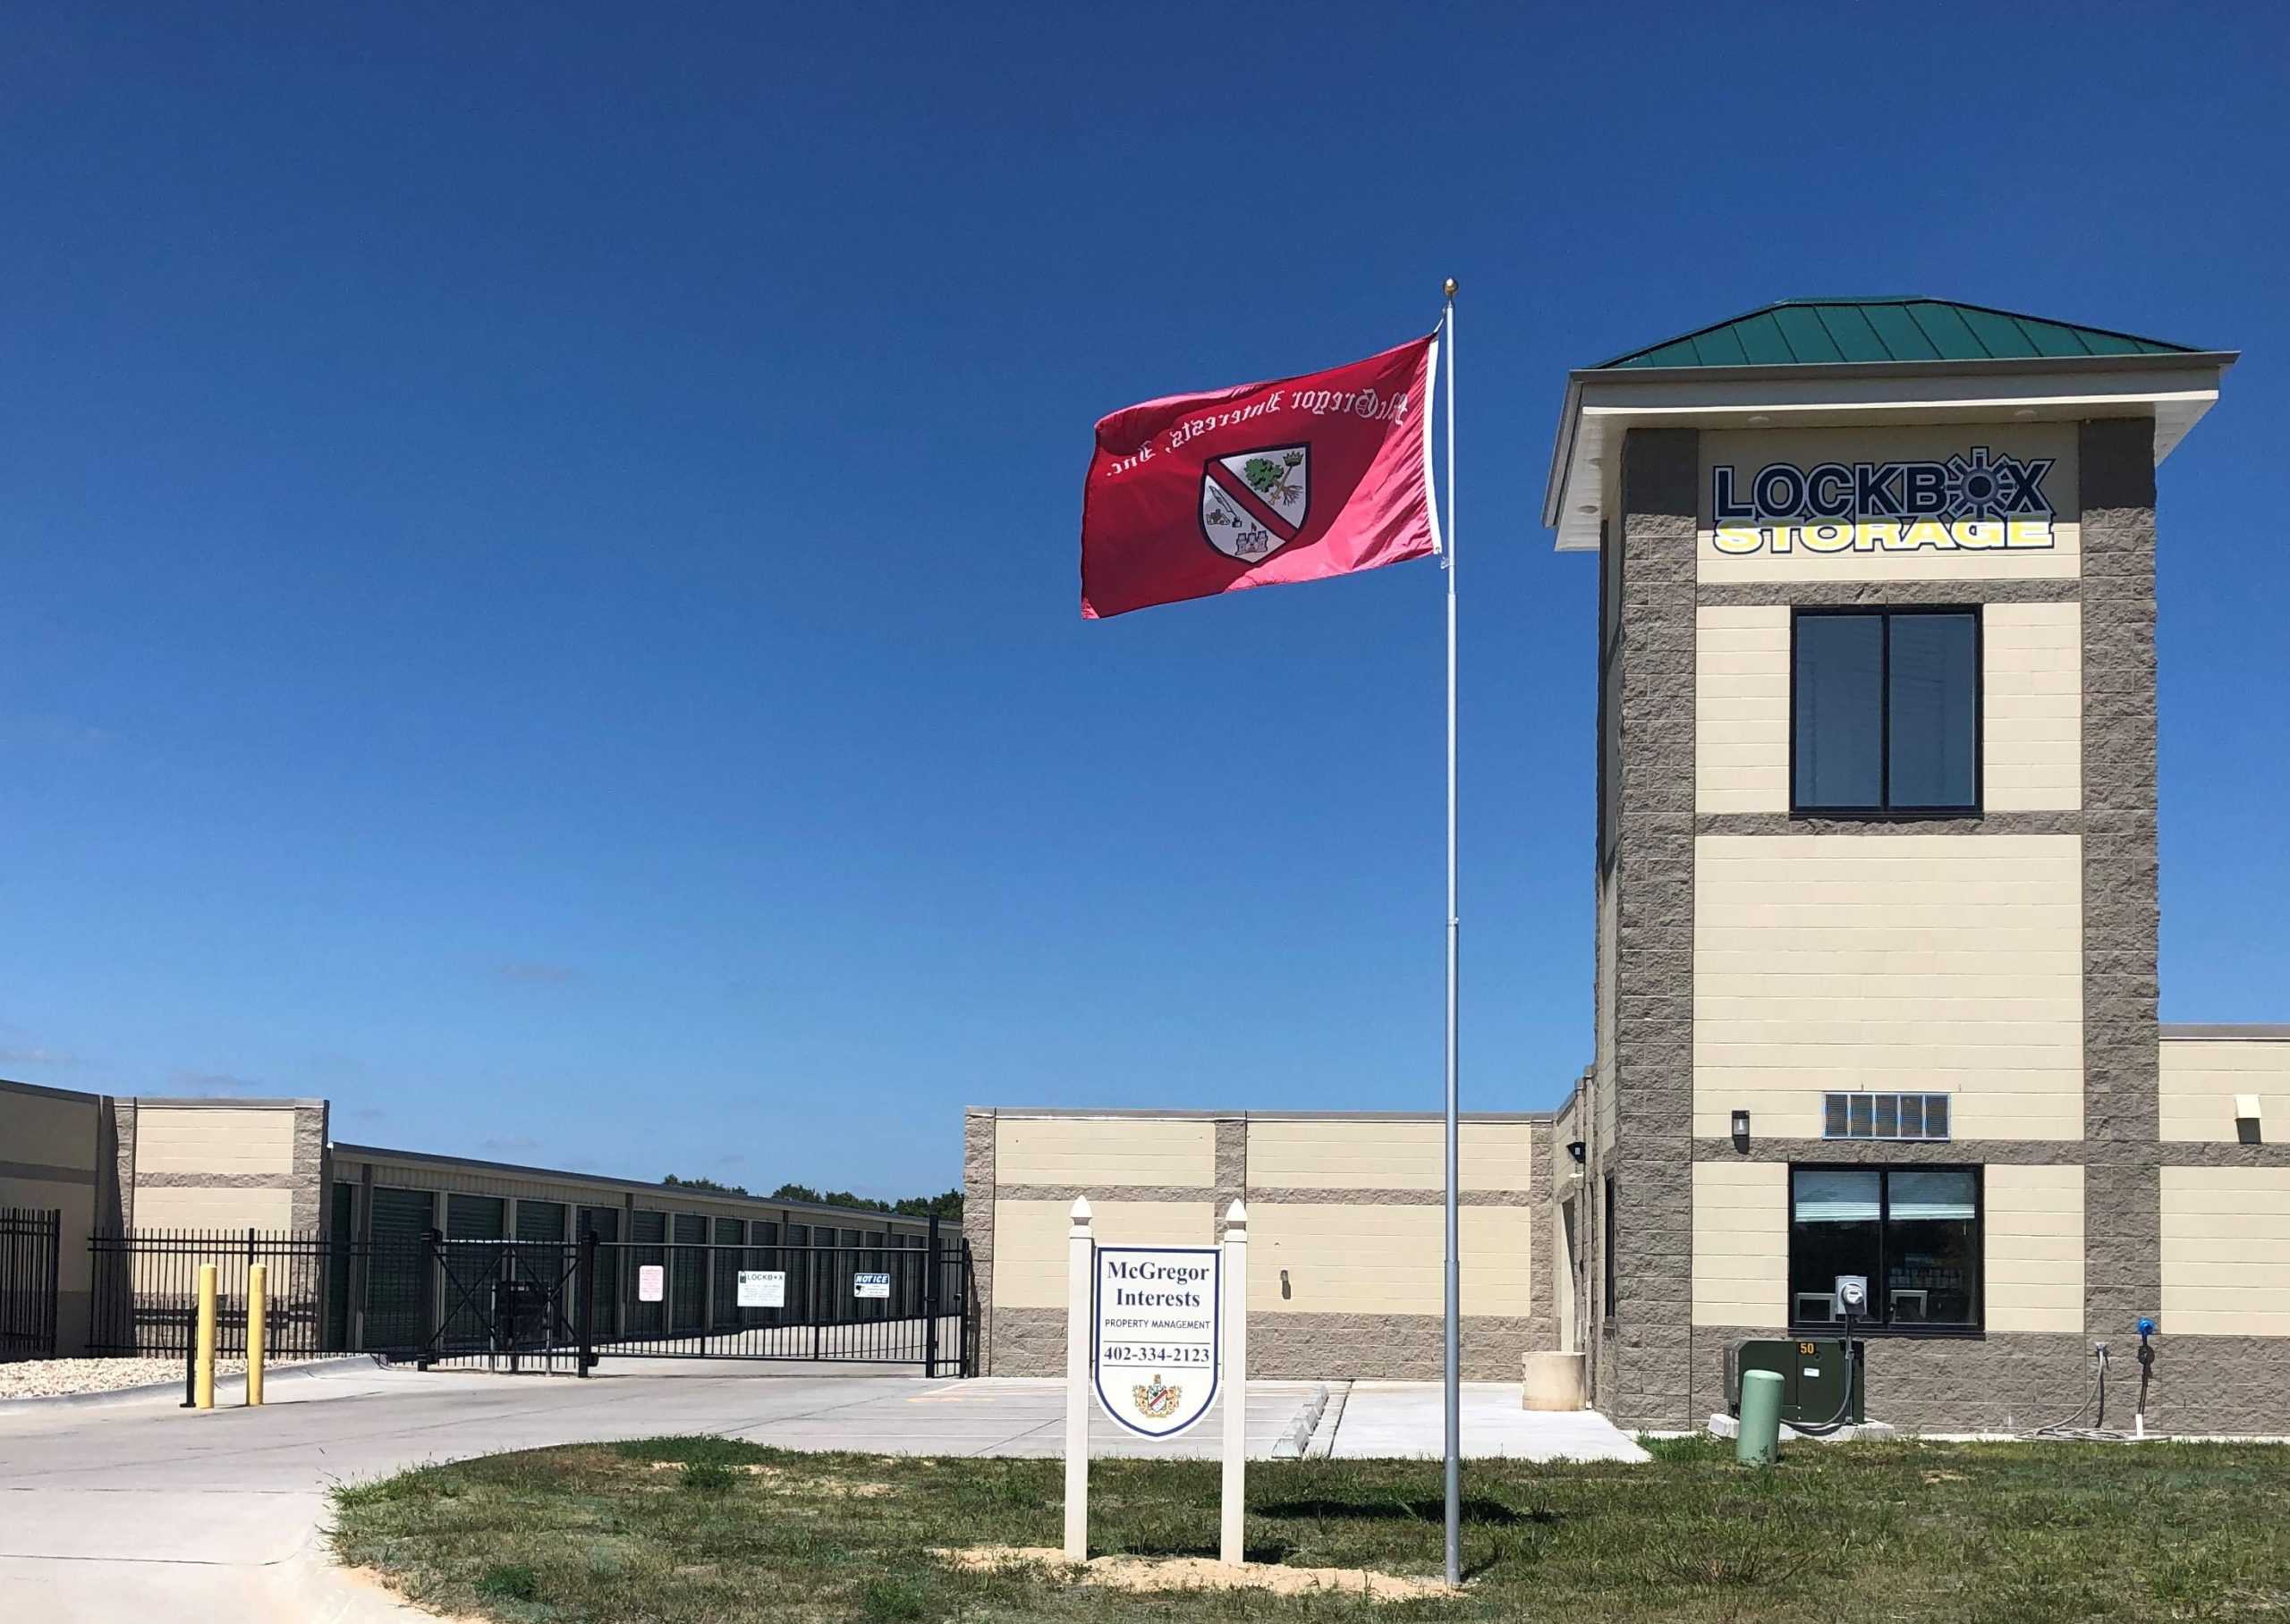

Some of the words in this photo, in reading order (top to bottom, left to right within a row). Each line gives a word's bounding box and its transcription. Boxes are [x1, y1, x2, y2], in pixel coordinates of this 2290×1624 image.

[1713, 446, 2057, 520] LOCKBOX
[1714, 514, 2054, 554] STORAGE
[855, 1275, 888, 1283] NOTICE
[1107, 1261, 1209, 1285] McGregor
[1116, 1288, 1200, 1307] Interests
[1105, 1319, 1149, 1329] PROPERTY
[1151, 1320, 1211, 1330] MANAGEMENT
[1104, 1347, 1209, 1362] 402-334-2123
[1800, 1342, 1814, 1354] 50
